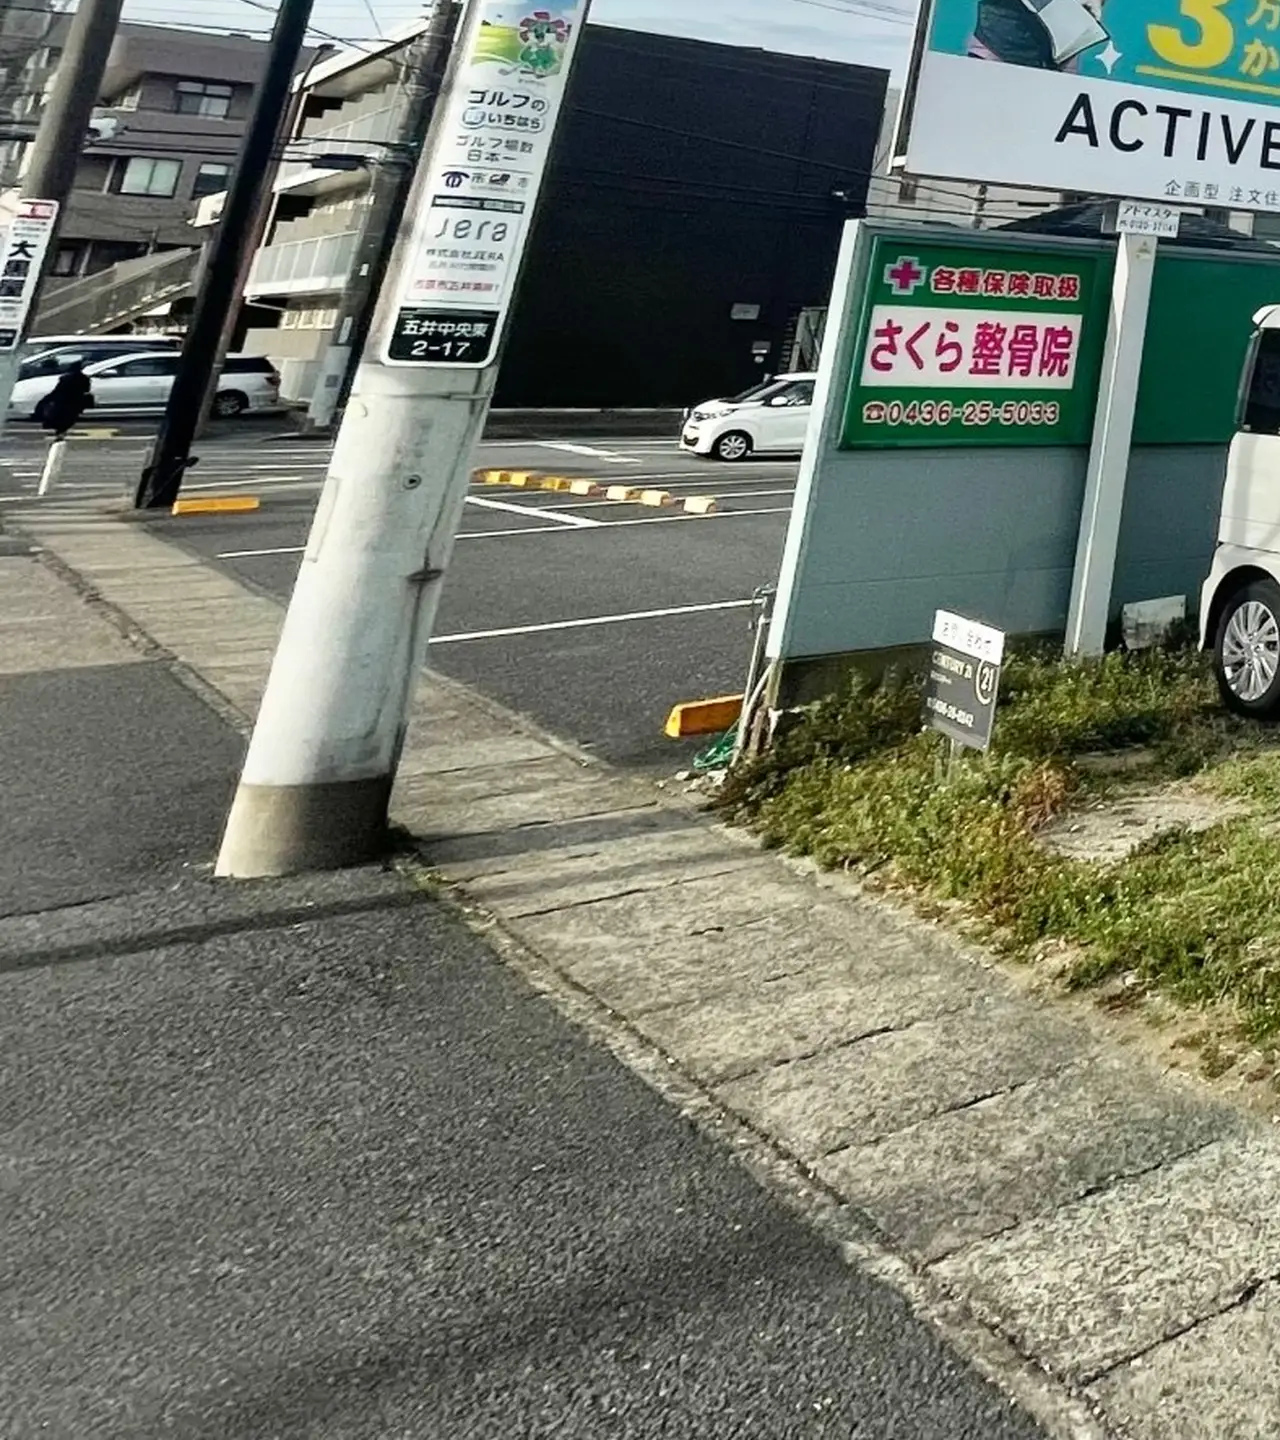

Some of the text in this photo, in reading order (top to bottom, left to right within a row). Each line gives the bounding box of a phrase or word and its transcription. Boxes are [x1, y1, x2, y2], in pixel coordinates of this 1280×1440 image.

[467, 89, 546, 113] ゴルフの
[463, 107, 542, 130] いちはら
[1163, 179, 1221, 202] 企画型
[930, 267, 1081, 302] 各種保険取扱
[402, 319, 489, 339] 五井中央東
[411, 340, 472, 358] 2-17
[869, 318, 1075, 378] さくら整骨院
